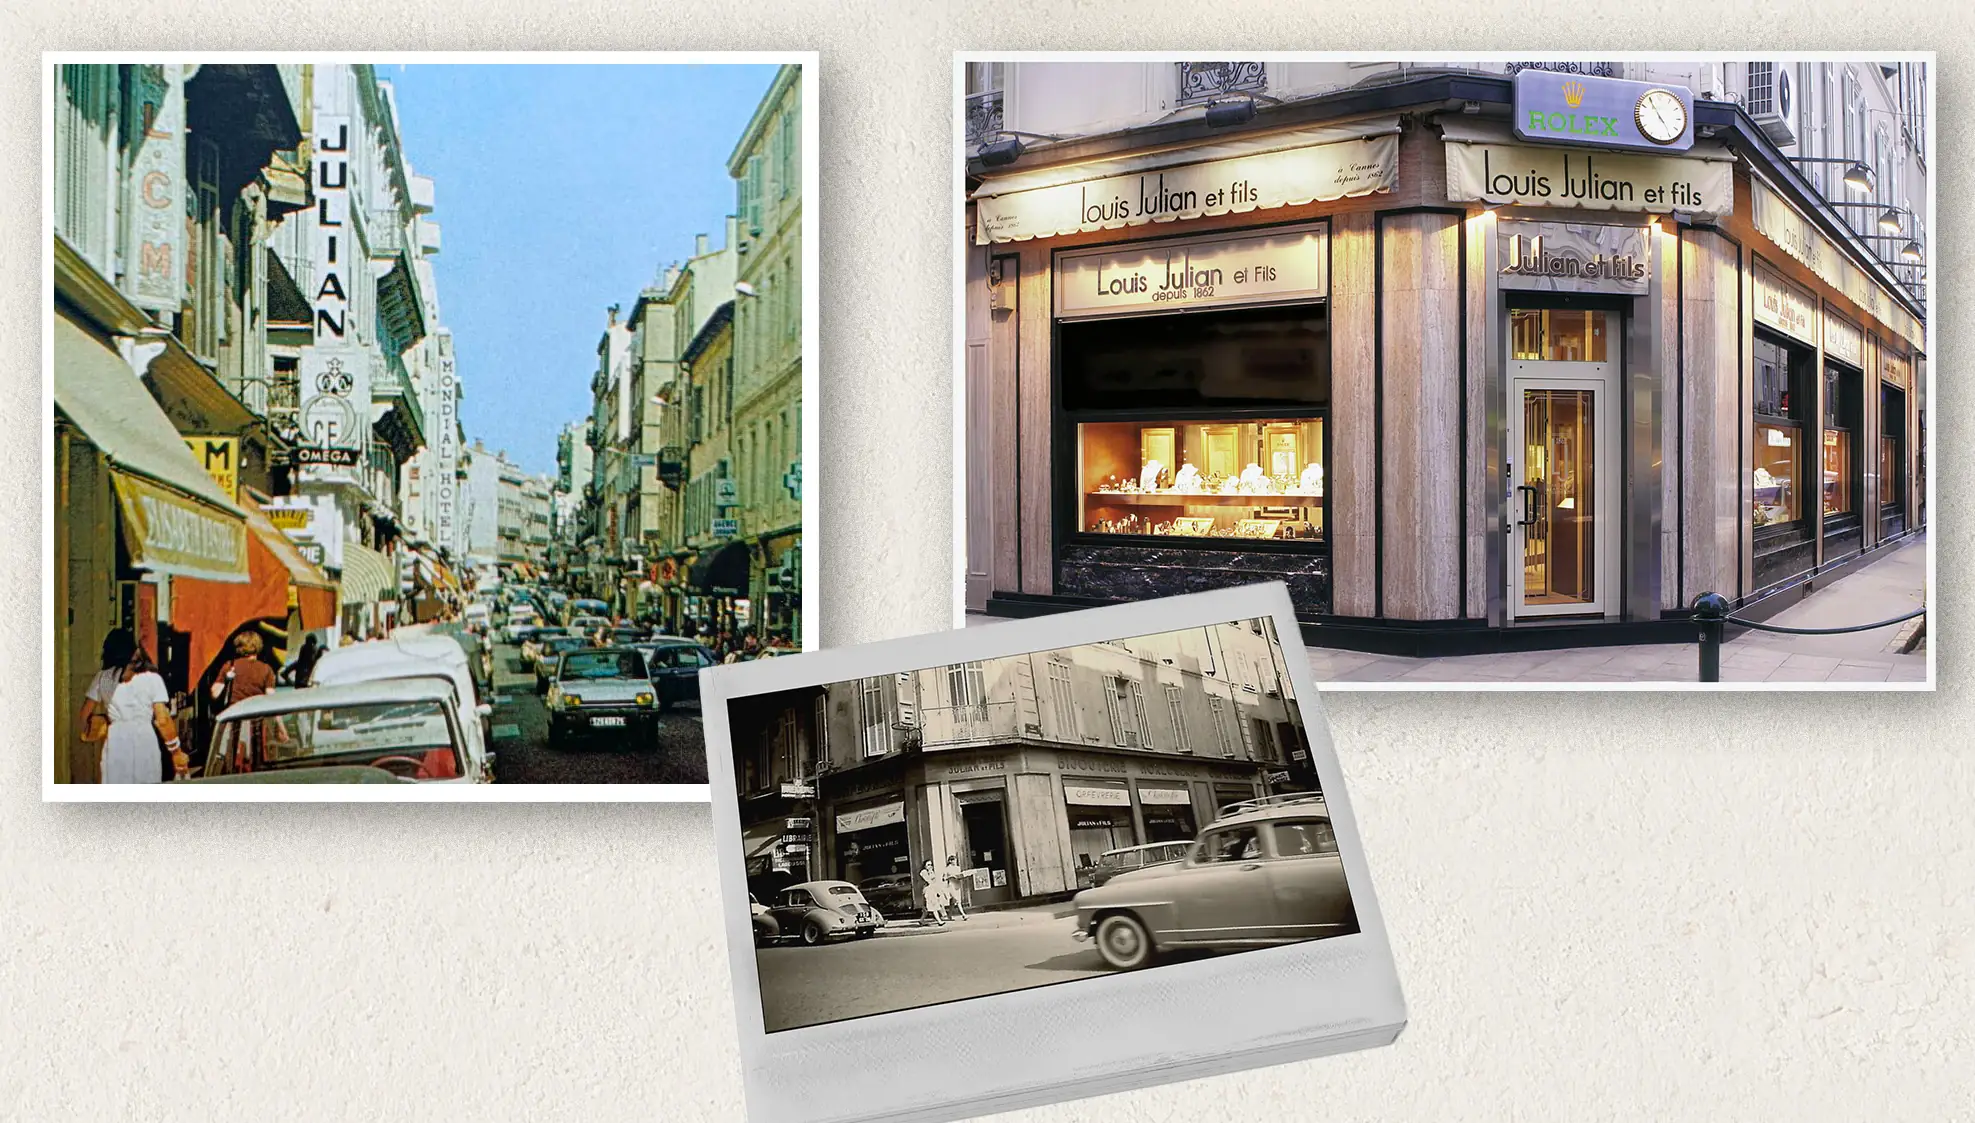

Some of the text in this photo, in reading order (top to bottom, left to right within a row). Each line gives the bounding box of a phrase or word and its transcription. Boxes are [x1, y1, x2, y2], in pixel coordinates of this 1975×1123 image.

[1528, 110, 1619, 137] ROLEX
[1349, 162, 1380, 172] Cannes
[1484, 149, 1702, 206] Louis Julian et fils
[1081, 173, 1258, 224] Louis Julian et fils
[316, 123, 349, 337] JULIAN
[1098, 248, 1277, 297] Louis Julian et Fils
[1508, 234, 1645, 279] Julian et fils
[1152, 286, 1215, 302] depuis 1862
[441, 361, 454, 459] MONDIAL
[298, 449, 352, 462] OMEGA
[440, 473, 452, 541] HOTEL
[948, 764, 980, 774] JULIAN
